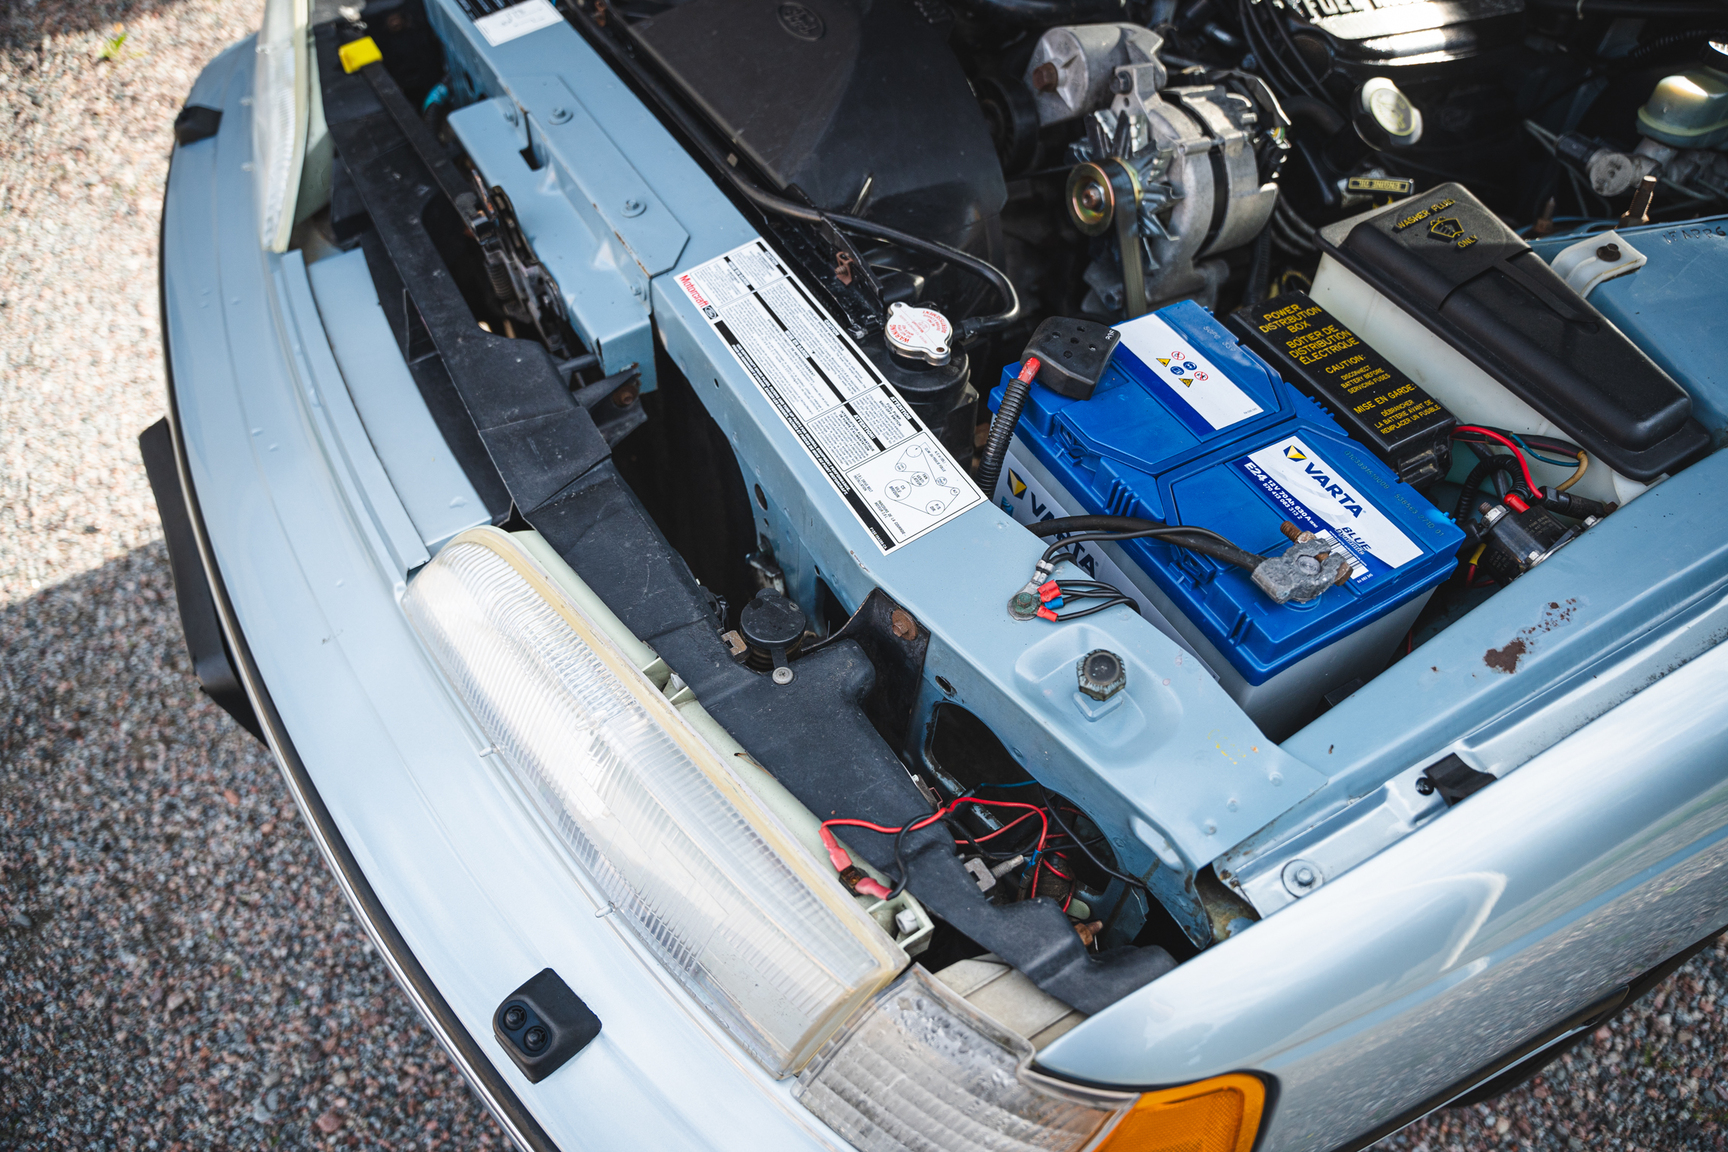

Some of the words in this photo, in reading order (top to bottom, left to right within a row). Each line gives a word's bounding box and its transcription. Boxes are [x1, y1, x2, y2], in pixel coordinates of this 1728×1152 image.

[1397, 210, 1430, 228] WASHER
[1431, 199, 1455, 211] FLUID
[1458, 235, 1477, 247] ONLY
[680, 275, 709, 308] Motorcraft
[1259, 306, 1322, 333] DISTRIBUTION
[1263, 304, 1301, 321] POWER
[890, 325, 911, 343] WARNING
[1286, 330, 1324, 348] BOÎTIER
[1322, 325, 1338, 335] DE
[1287, 320, 1311, 333] BOX
[1289, 330, 1352, 358] DISTRIBUTION
[1299, 337, 1359, 365] ÉLECTRIQUE
[1325, 355, 1365, 373] CAUTION:
[1341, 365, 1371, 380] DISCONNECT
[1341, 376, 1364, 388] BATTERY
[1363, 368, 1384, 379] BEFORE
[1348, 380, 1374, 394] SERVICING
[1373, 373, 1390, 383] FUSES
[888, 395, 912, 420] ATTENTION
[1353, 401, 1376, 414] MISE
[1375, 396, 1388, 404] EN
[1388, 384, 1416, 398] GARDE:
[1381, 400, 1414, 416] DÉBRANCHER
[1380, 418, 1412, 434] REMPLACER
[1419, 404, 1441, 417] FUSIBLE
[1383, 411, 1408, 424] BATTERIE
[1408, 403, 1424, 413] AVANT
[1242, 459, 1269, 483] E24
[1262, 481, 1273, 492] 570
[1270, 489, 1281, 500] 413
[1288, 506, 1299, 516] 313
[1266, 479, 1280, 492] 12V
[1278, 490, 1296, 506] 70Ah
[1301, 461, 1366, 519] VARTA
[1339, 524, 1373, 552] BLUE
